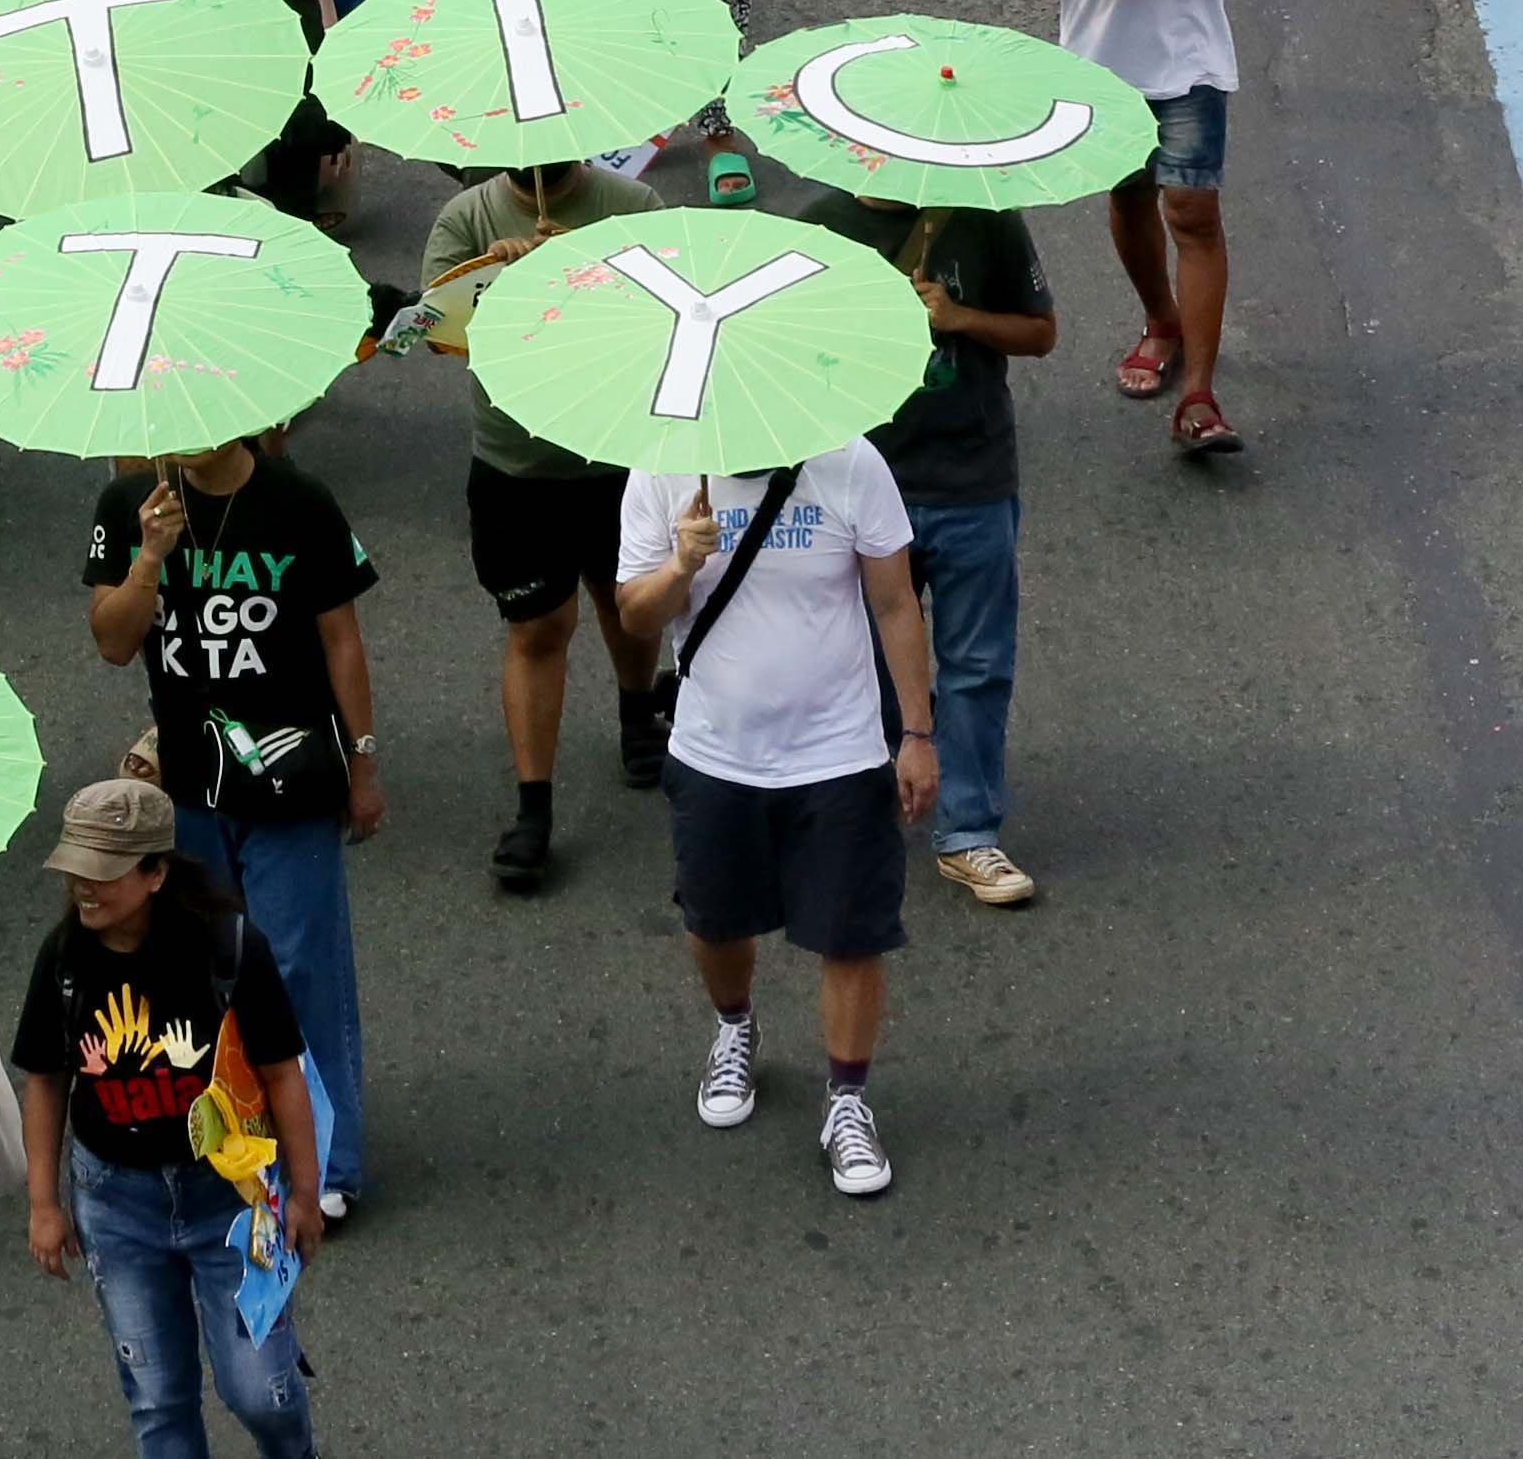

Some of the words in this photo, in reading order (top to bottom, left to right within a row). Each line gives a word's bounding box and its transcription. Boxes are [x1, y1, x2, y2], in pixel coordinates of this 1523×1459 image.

[717, 508, 749, 529] END
[792, 505, 824, 526] AGE
[720, 532, 737, 553] OF
[761, 528, 813, 549] ASTIC
[94, 1068, 203, 1125] gaia
